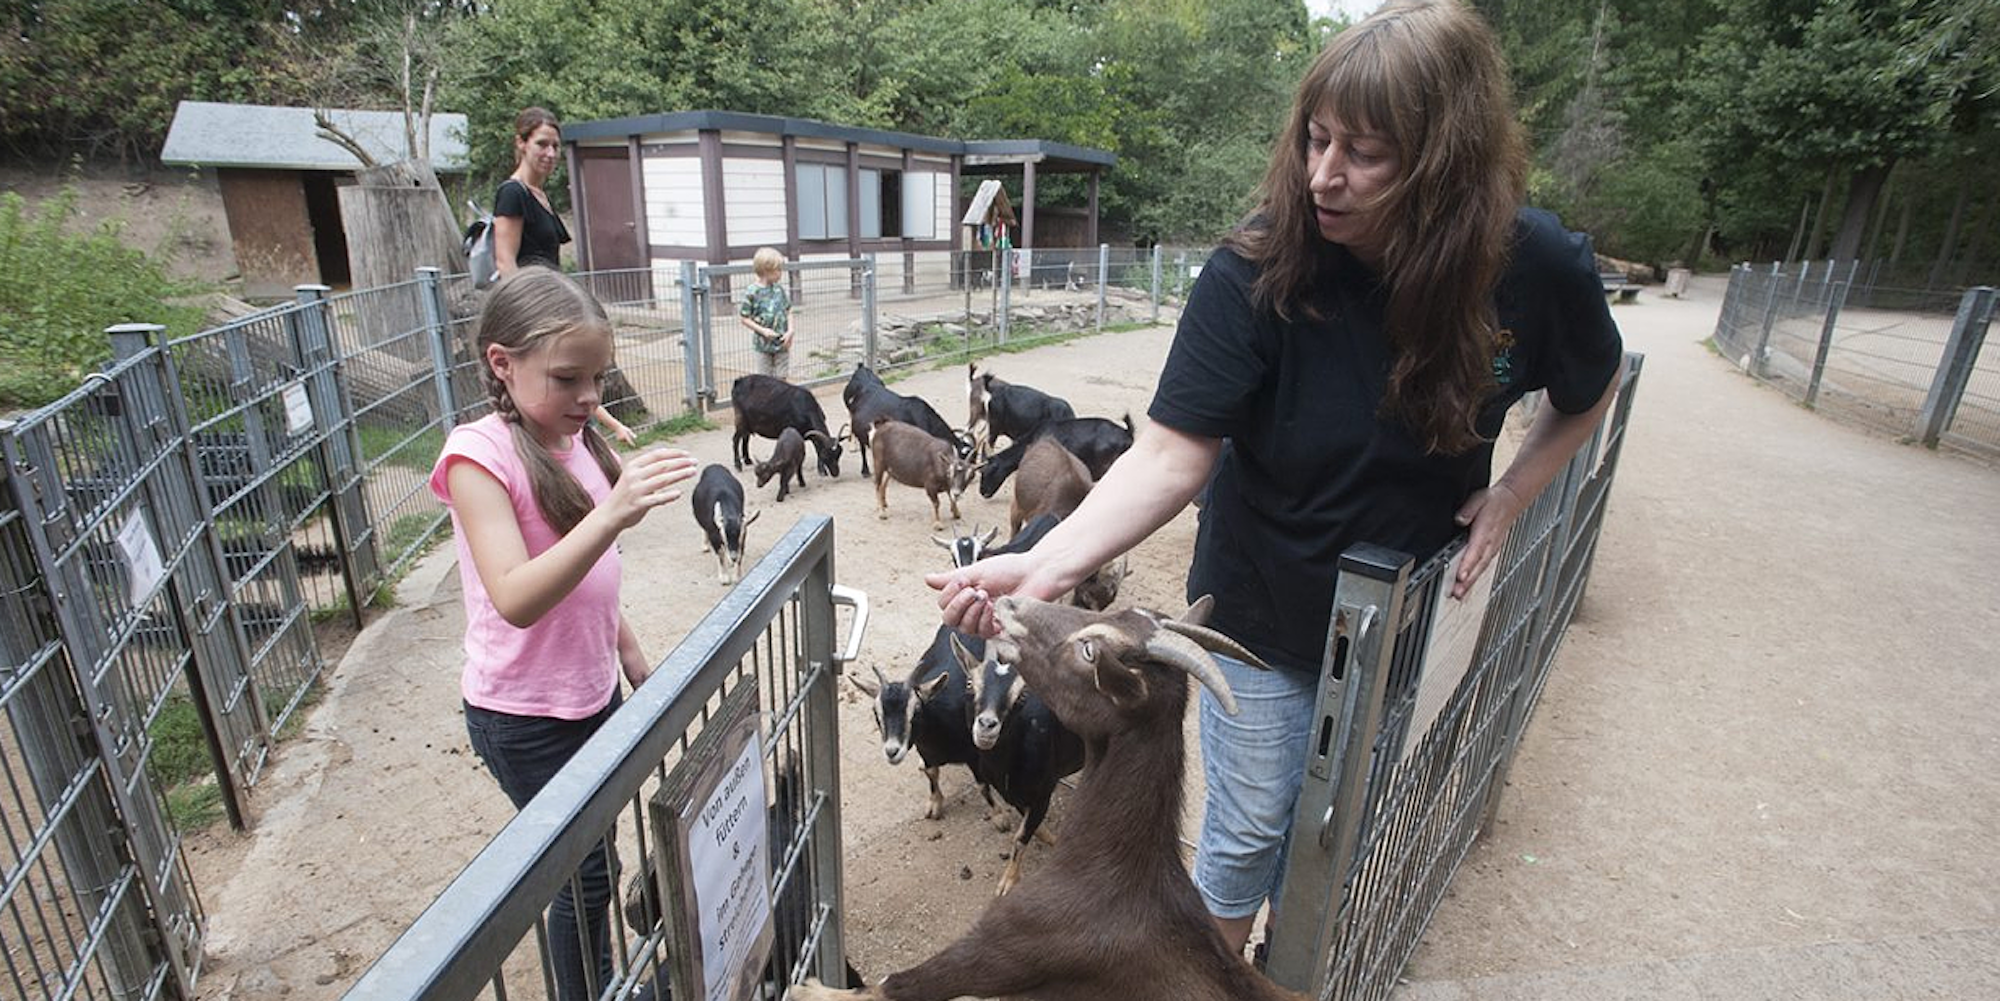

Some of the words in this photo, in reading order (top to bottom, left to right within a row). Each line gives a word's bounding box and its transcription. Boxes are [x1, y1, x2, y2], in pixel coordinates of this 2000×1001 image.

[702, 796, 723, 828] Von
[723, 757, 751, 801] außen
[716, 796, 748, 847] füttern
[732, 841, 740, 860] &
[716, 898, 729, 924] im
